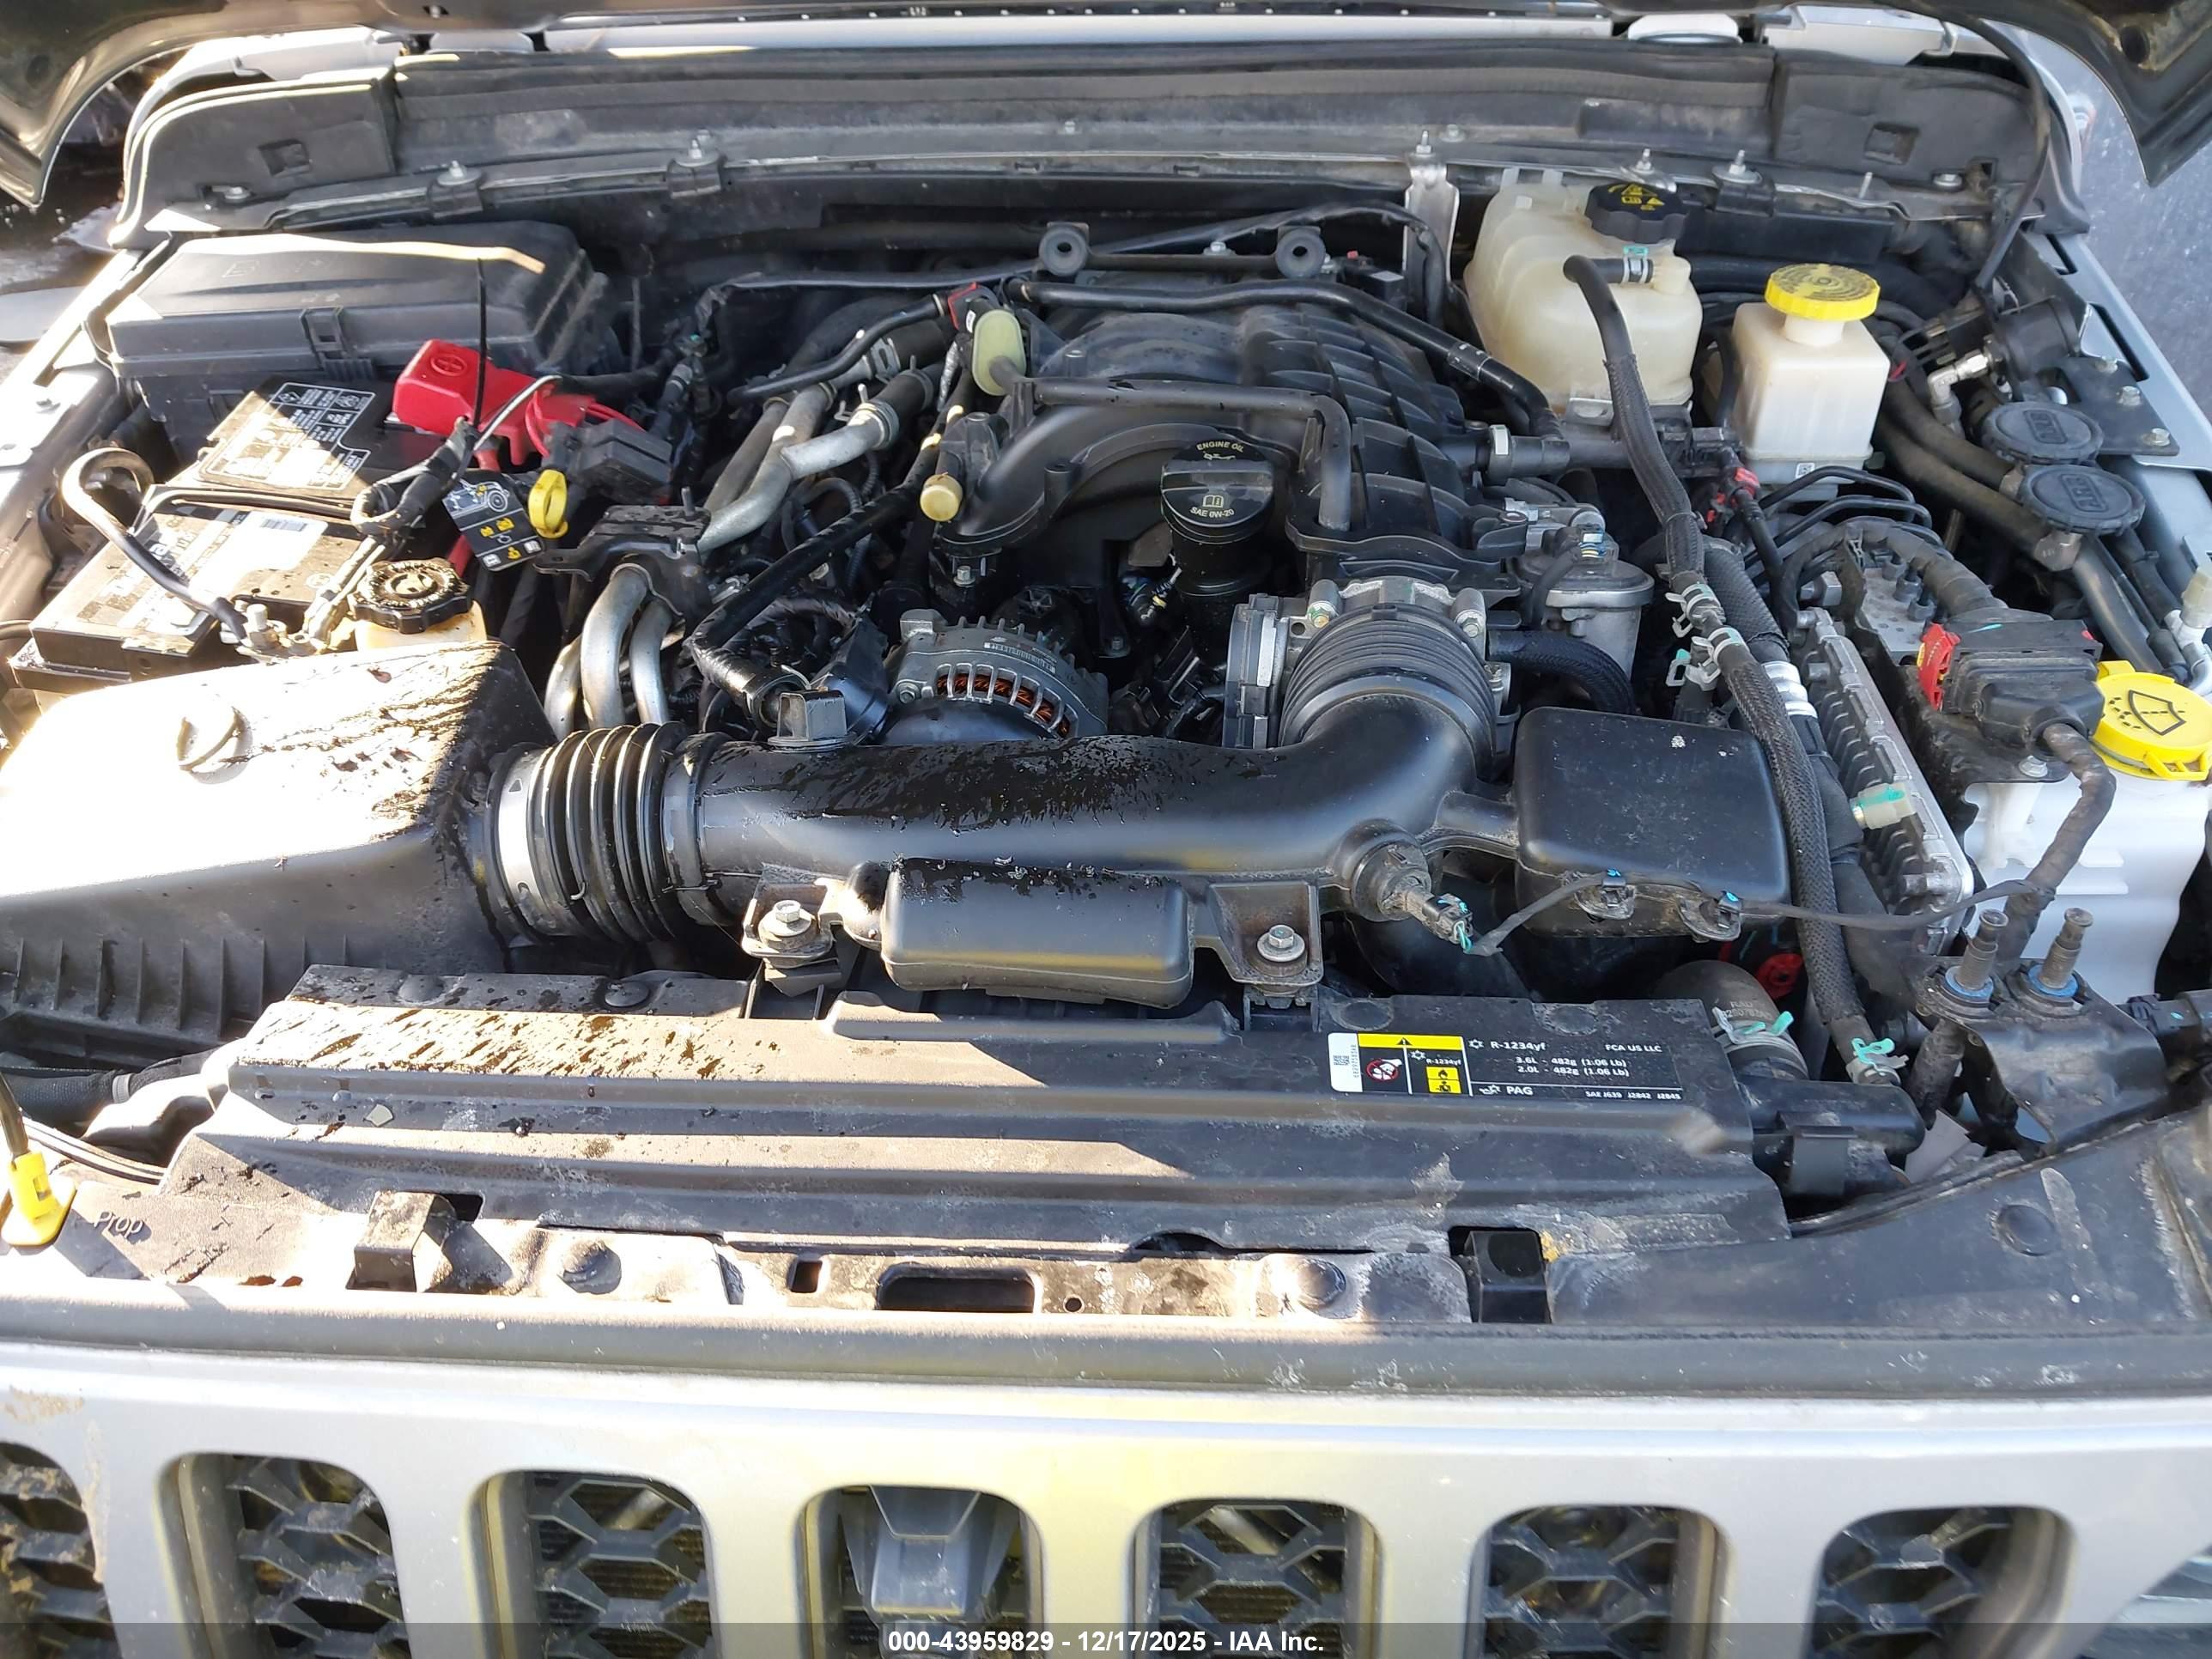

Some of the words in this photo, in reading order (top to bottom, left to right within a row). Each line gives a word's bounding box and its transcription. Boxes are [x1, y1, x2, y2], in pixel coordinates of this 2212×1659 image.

[1196, 441, 1231, 451] ENGINE
[1231, 443, 1244, 453] OIL
[1190, 507, 1208, 517] SAE
[1209, 508, 1235, 519] 0W-20
[1490, 1041, 1547, 1051] R-1234yf
[1516, 1056, 1537, 1065] 3.6L
[1551, 1058, 1577, 1066] 482g
[1553, 1066, 1579, 1075] 482g
[1583, 1067, 1611, 1077] (1.06
[1613, 1068, 1630, 1077] Lb)
[1506, 1086, 1534, 1096] PAG
[93, 1210, 143, 1238] Prop
